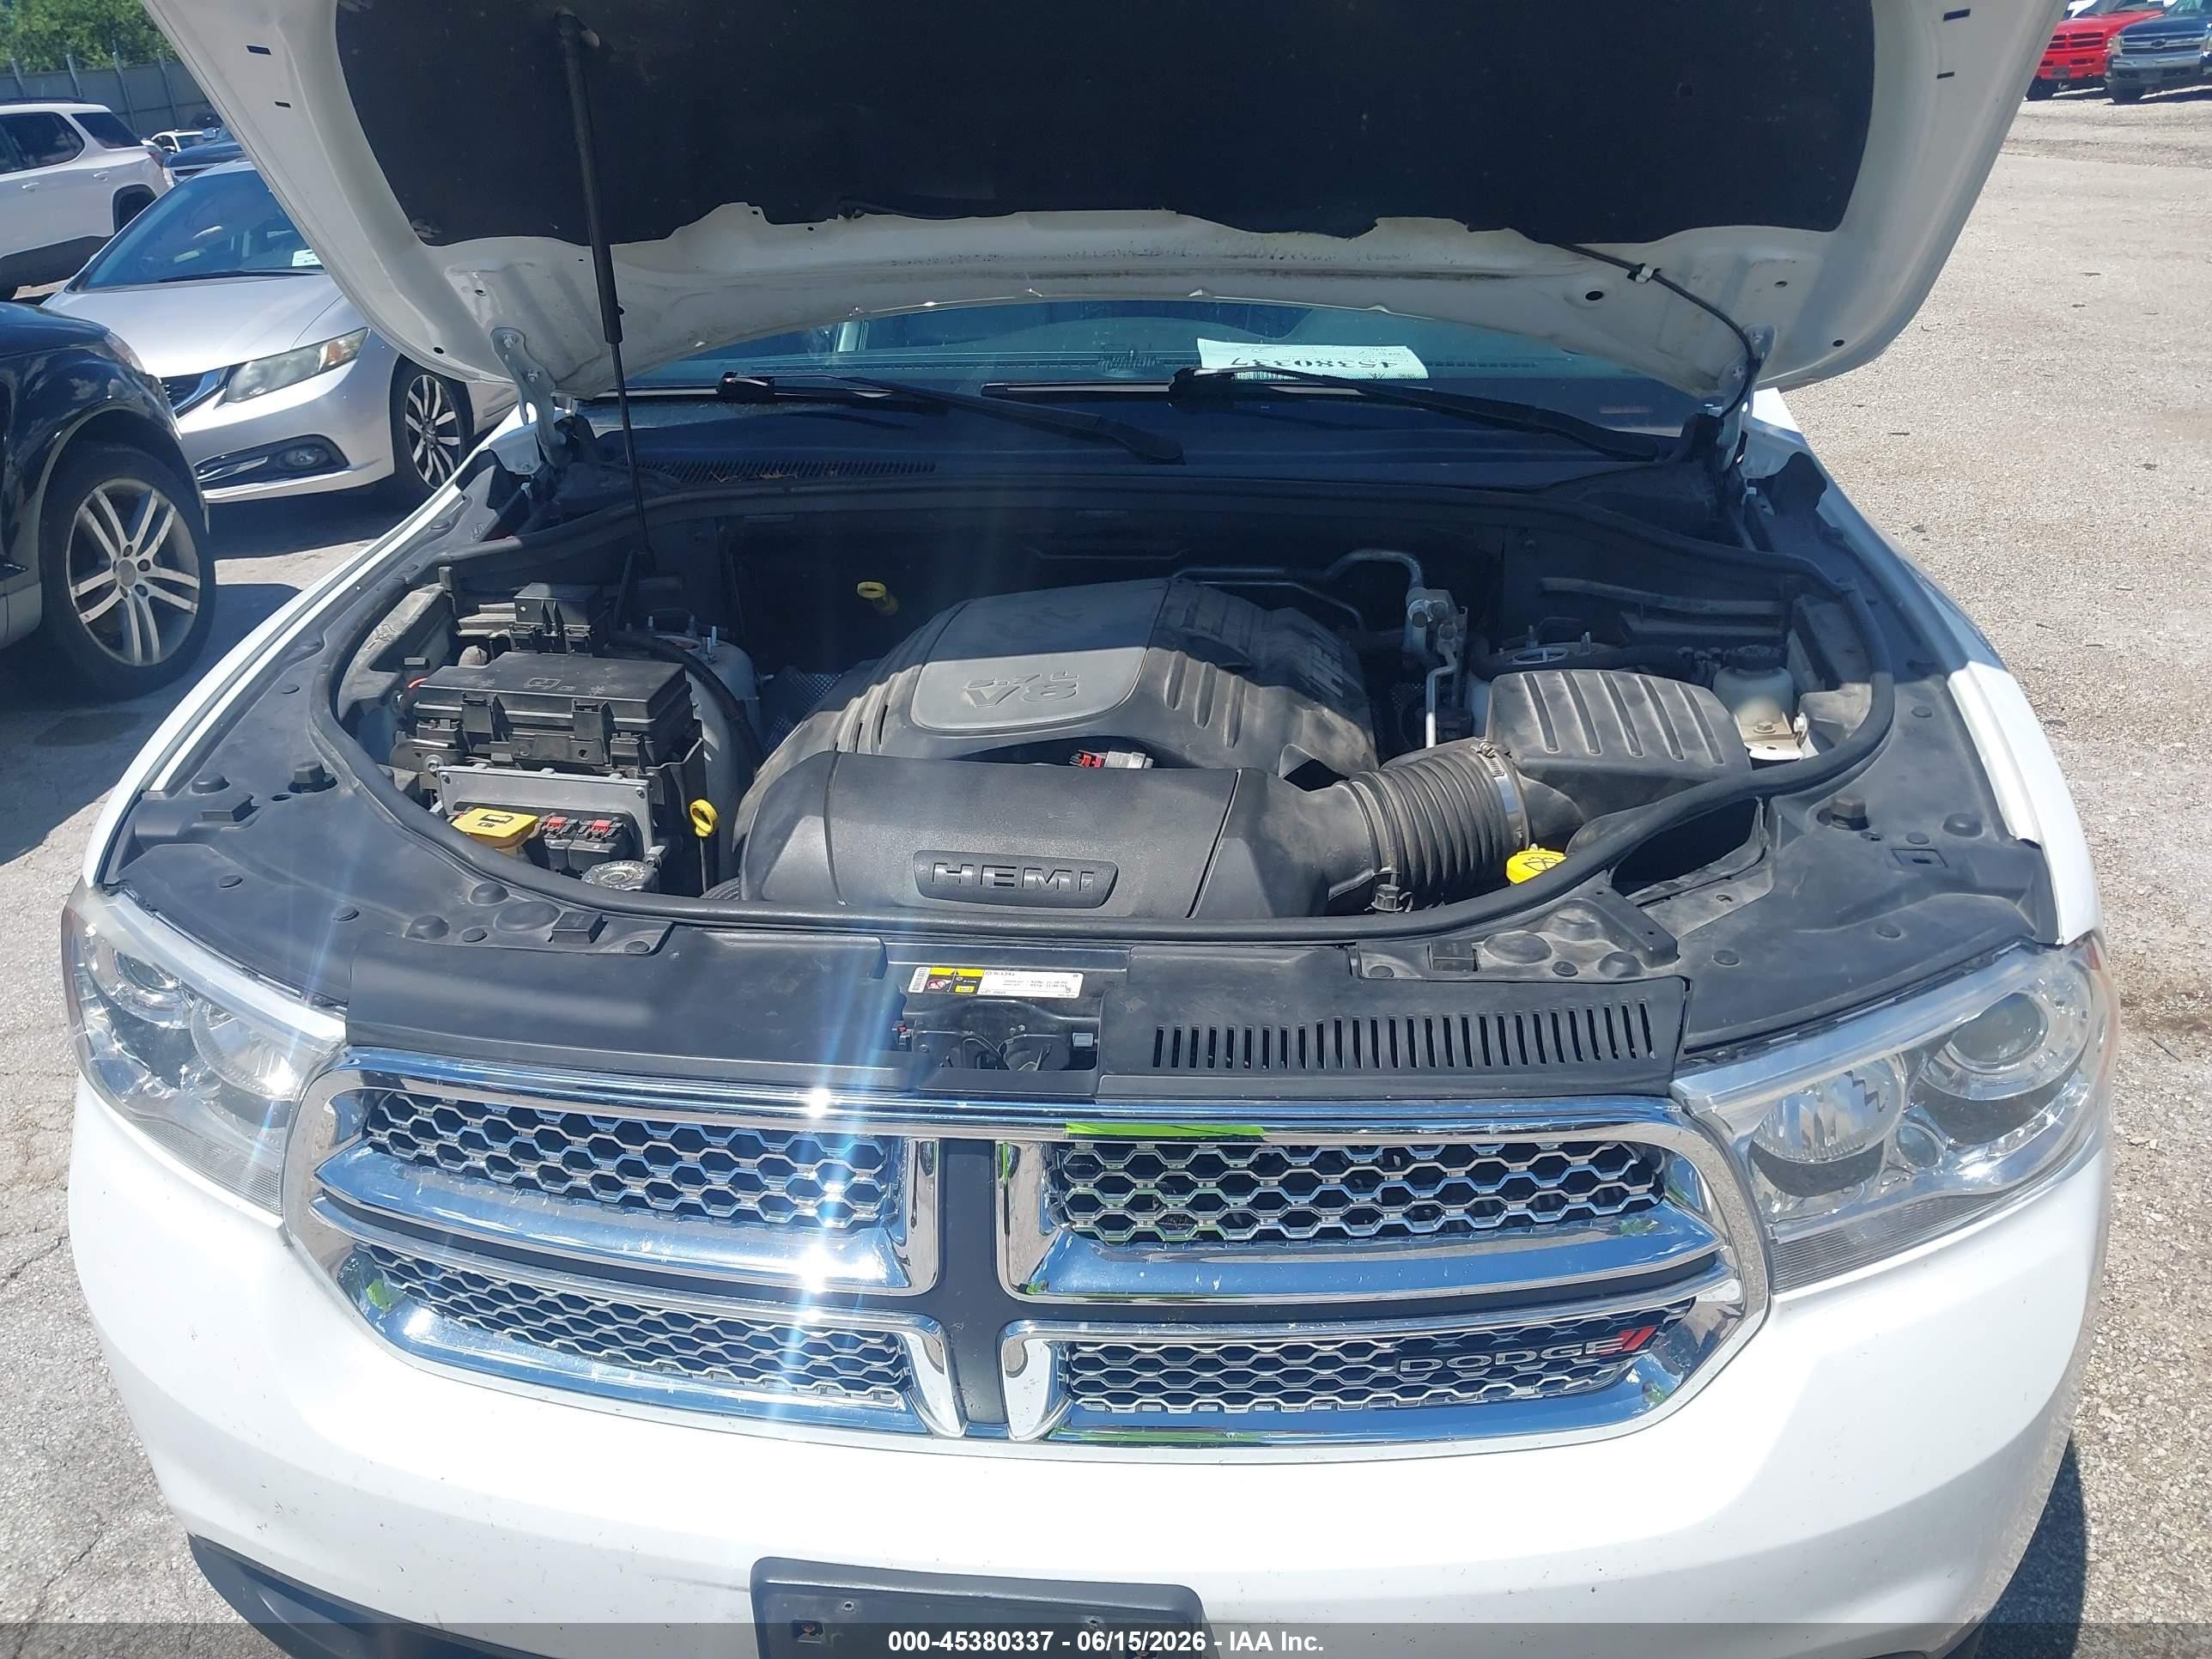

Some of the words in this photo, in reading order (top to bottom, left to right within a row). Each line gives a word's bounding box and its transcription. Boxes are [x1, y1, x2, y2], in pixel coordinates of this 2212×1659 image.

[1231, 357, 1399, 369] 45380337
[932, 862, 1095, 893] HEMI
[1399, 1337, 1626, 1373] DODGE
